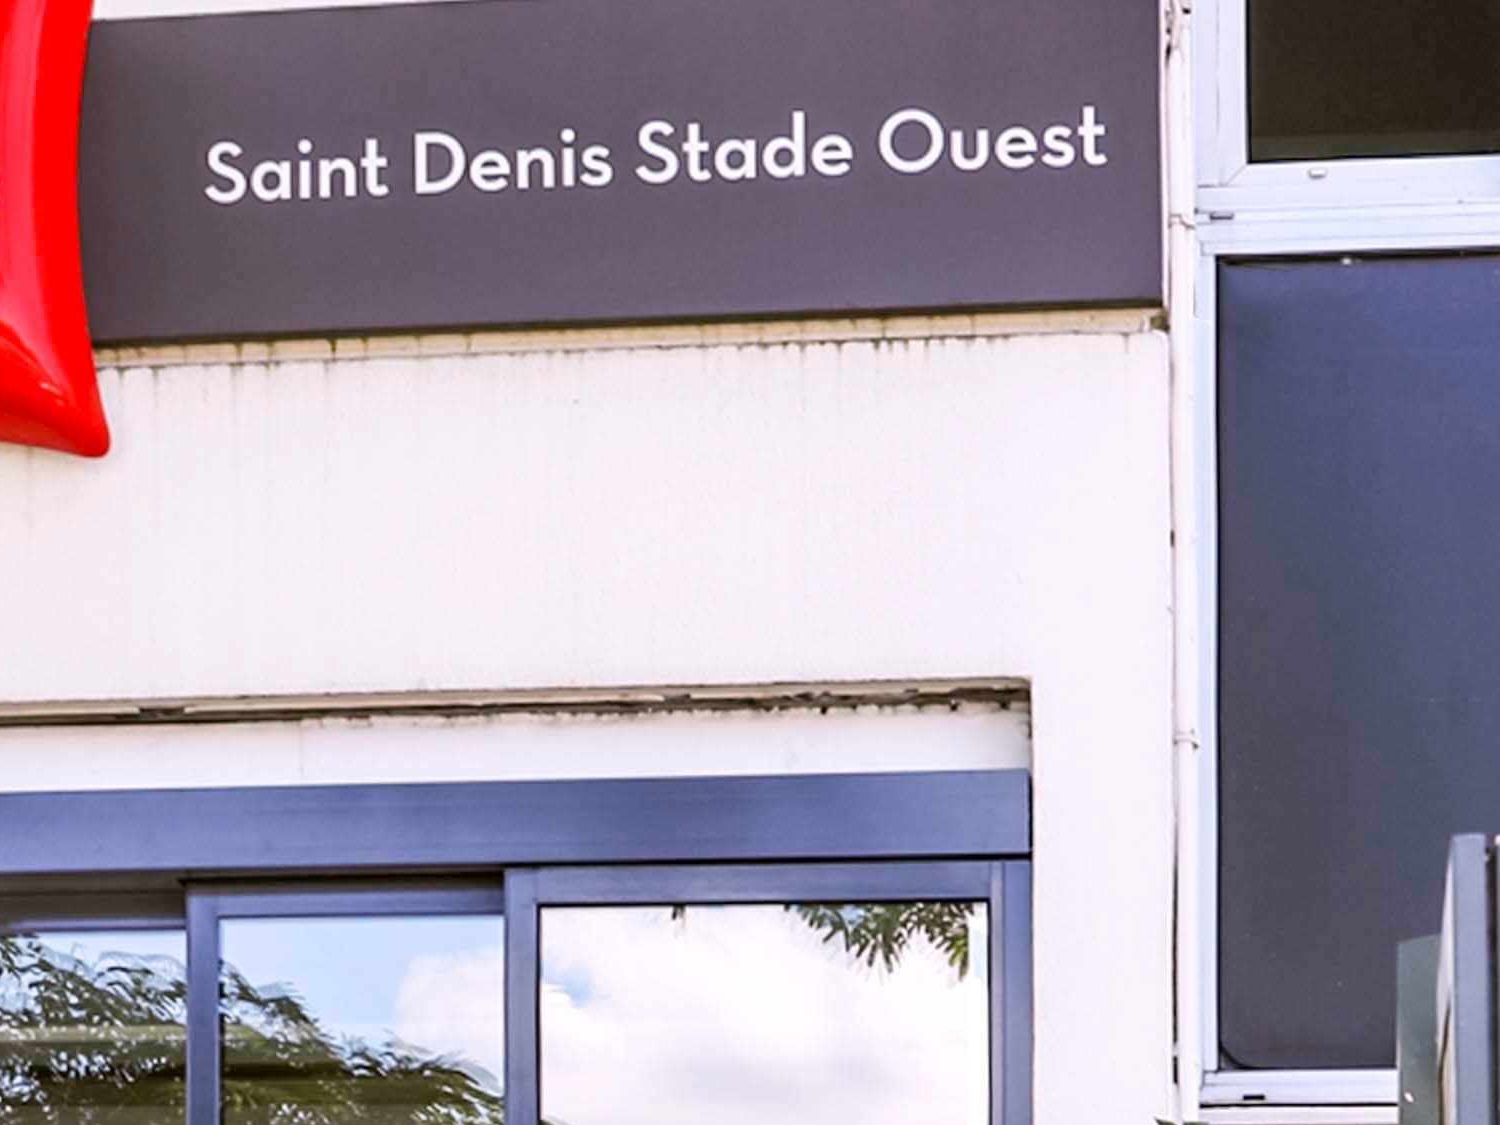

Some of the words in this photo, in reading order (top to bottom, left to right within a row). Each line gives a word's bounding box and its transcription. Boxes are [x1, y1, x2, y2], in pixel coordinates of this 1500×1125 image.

[203, 138, 390, 204] Saint
[414, 128, 613, 195] Denis
[635, 110, 854, 184] Stade
[878, 105, 1108, 174] Ouest
